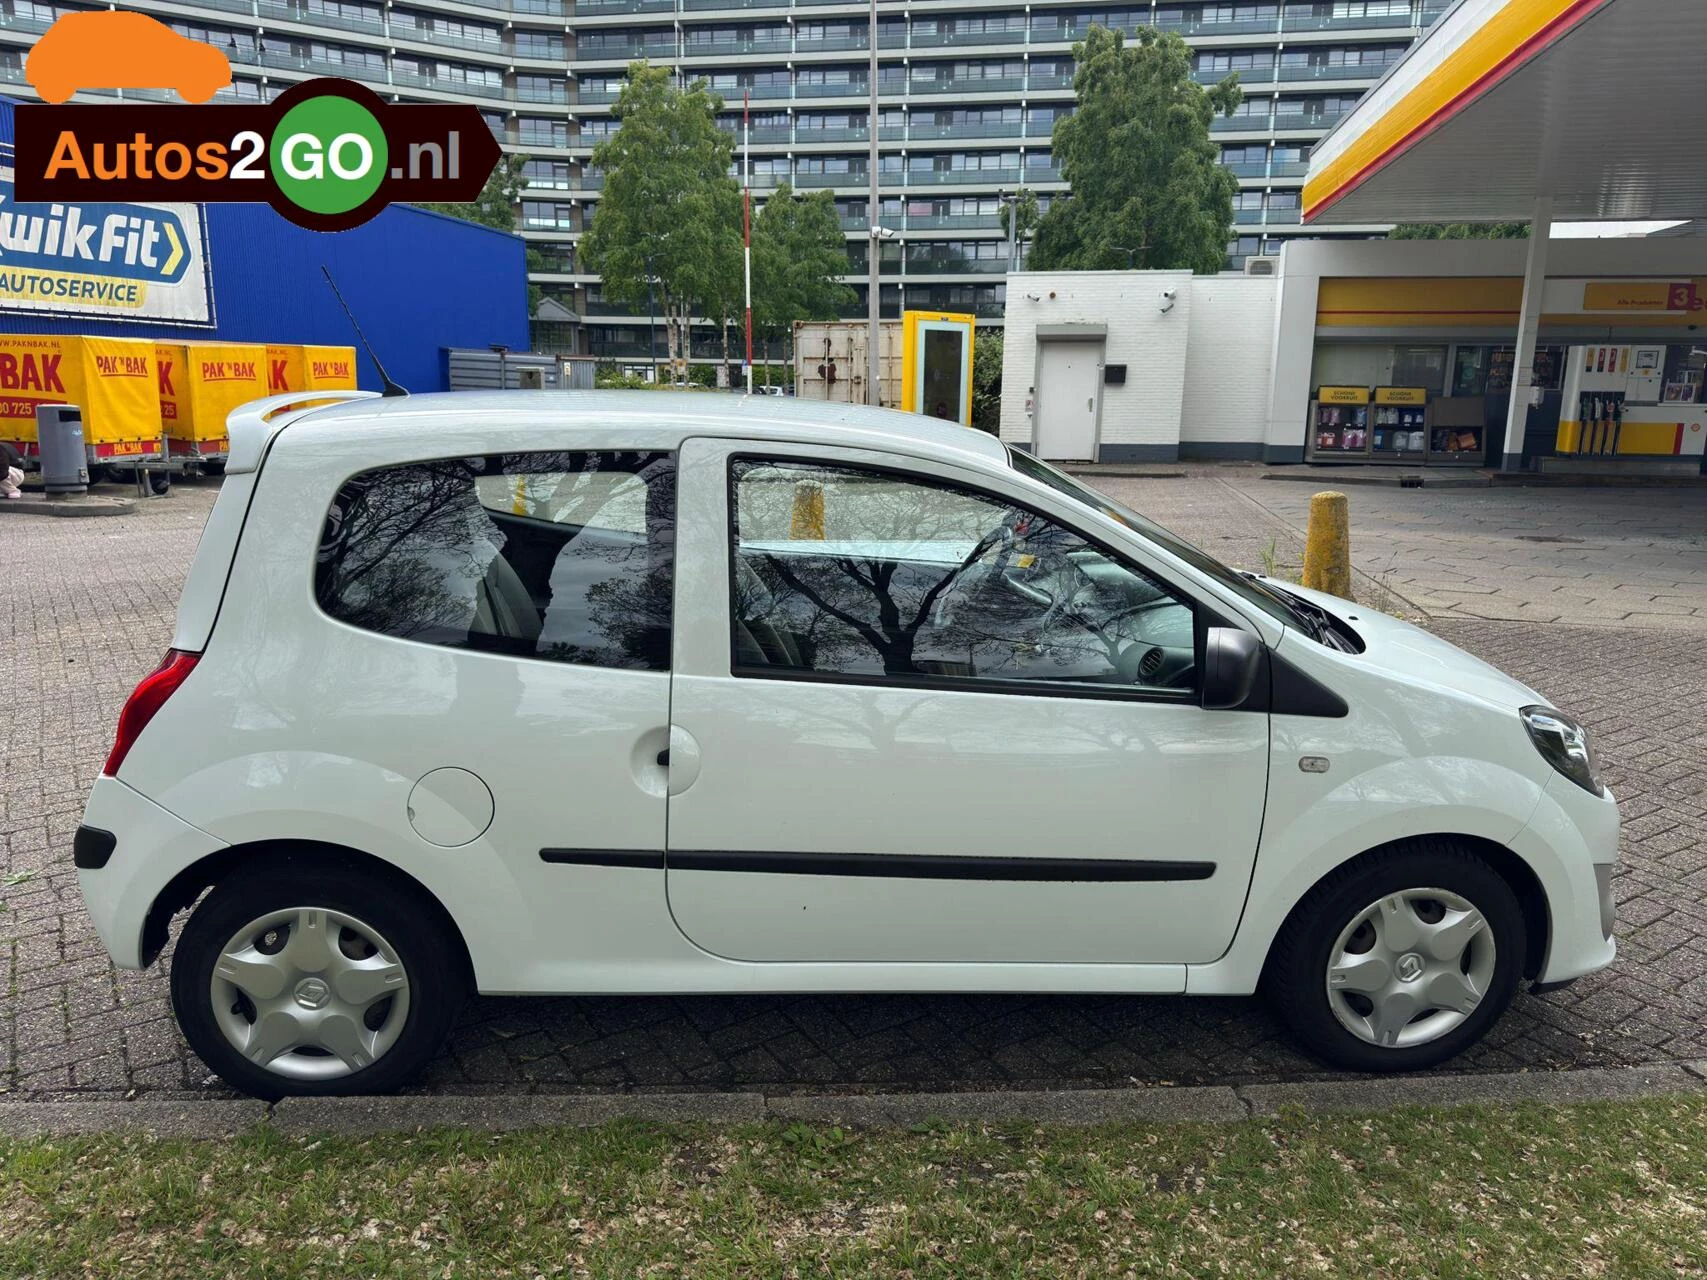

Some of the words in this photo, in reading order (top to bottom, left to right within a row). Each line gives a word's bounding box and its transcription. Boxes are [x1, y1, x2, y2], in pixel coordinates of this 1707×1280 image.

[0, 195, 98, 261] wik
[0, 272, 138, 302] AUTOSERVICE
[1673, 288, 1689, 306] 3
[0, 352, 66, 394] BAK
[202, 362, 225, 378] PAK
[233, 362, 256, 378] BAK
[312, 361, 329, 377] PAK
[12, 402, 32, 415] 725
